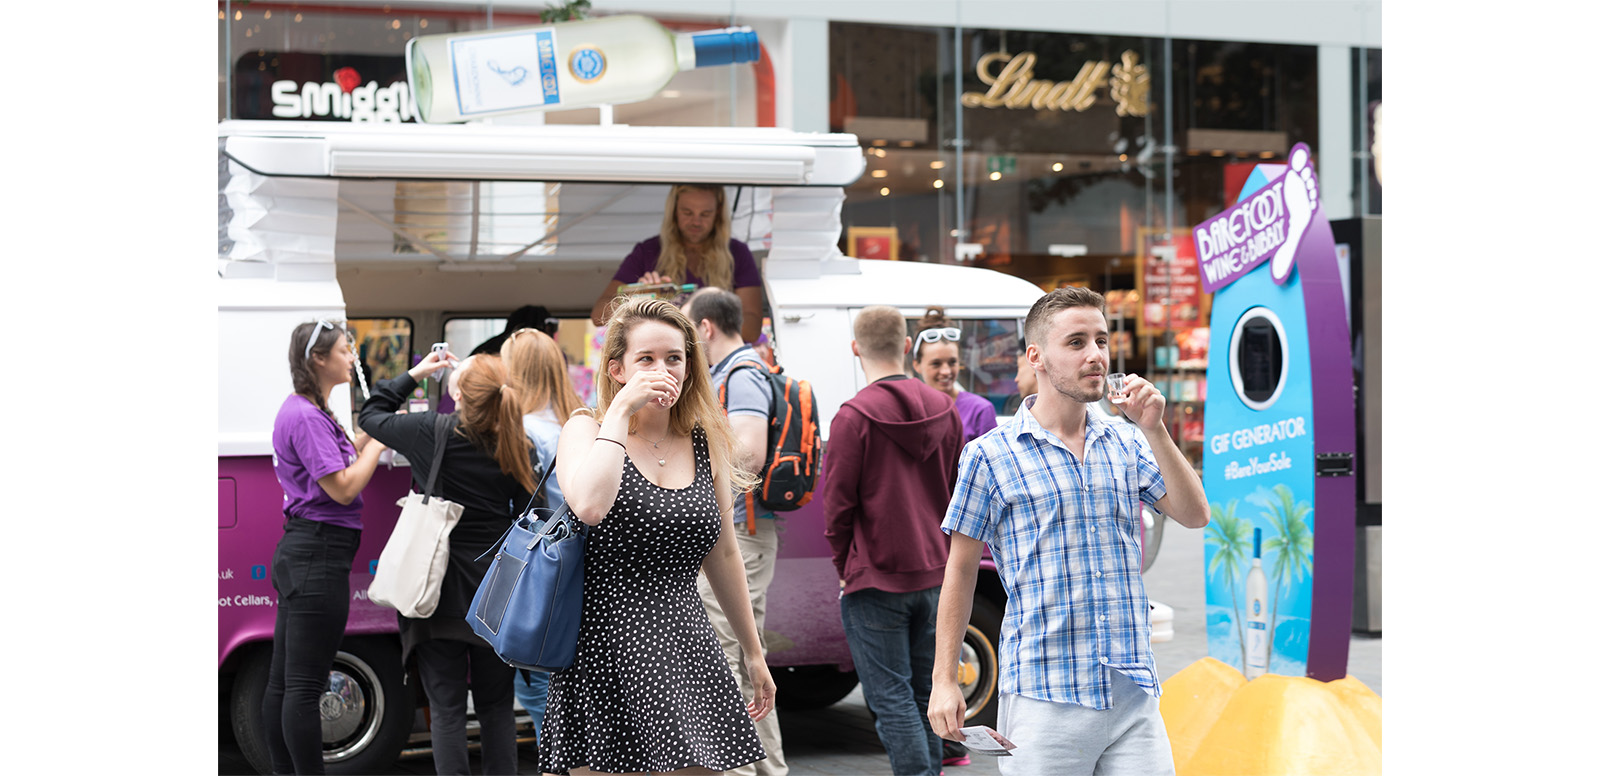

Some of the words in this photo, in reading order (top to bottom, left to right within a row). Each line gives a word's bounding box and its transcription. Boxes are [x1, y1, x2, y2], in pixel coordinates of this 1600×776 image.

[271, 67, 416, 122] Smiggl
[961, 52, 1112, 112] Lindt
[1196, 181, 1285, 262] BAREFOOT
[1203, 247, 1244, 285] WINE
[1210, 432, 1231, 455] GIF
[1231, 416, 1307, 450] GENERATOR
[1224, 450, 1292, 480] #BareYourSole
[218, 596, 232, 607] ot
[234, 594, 274, 607] Cellars,
